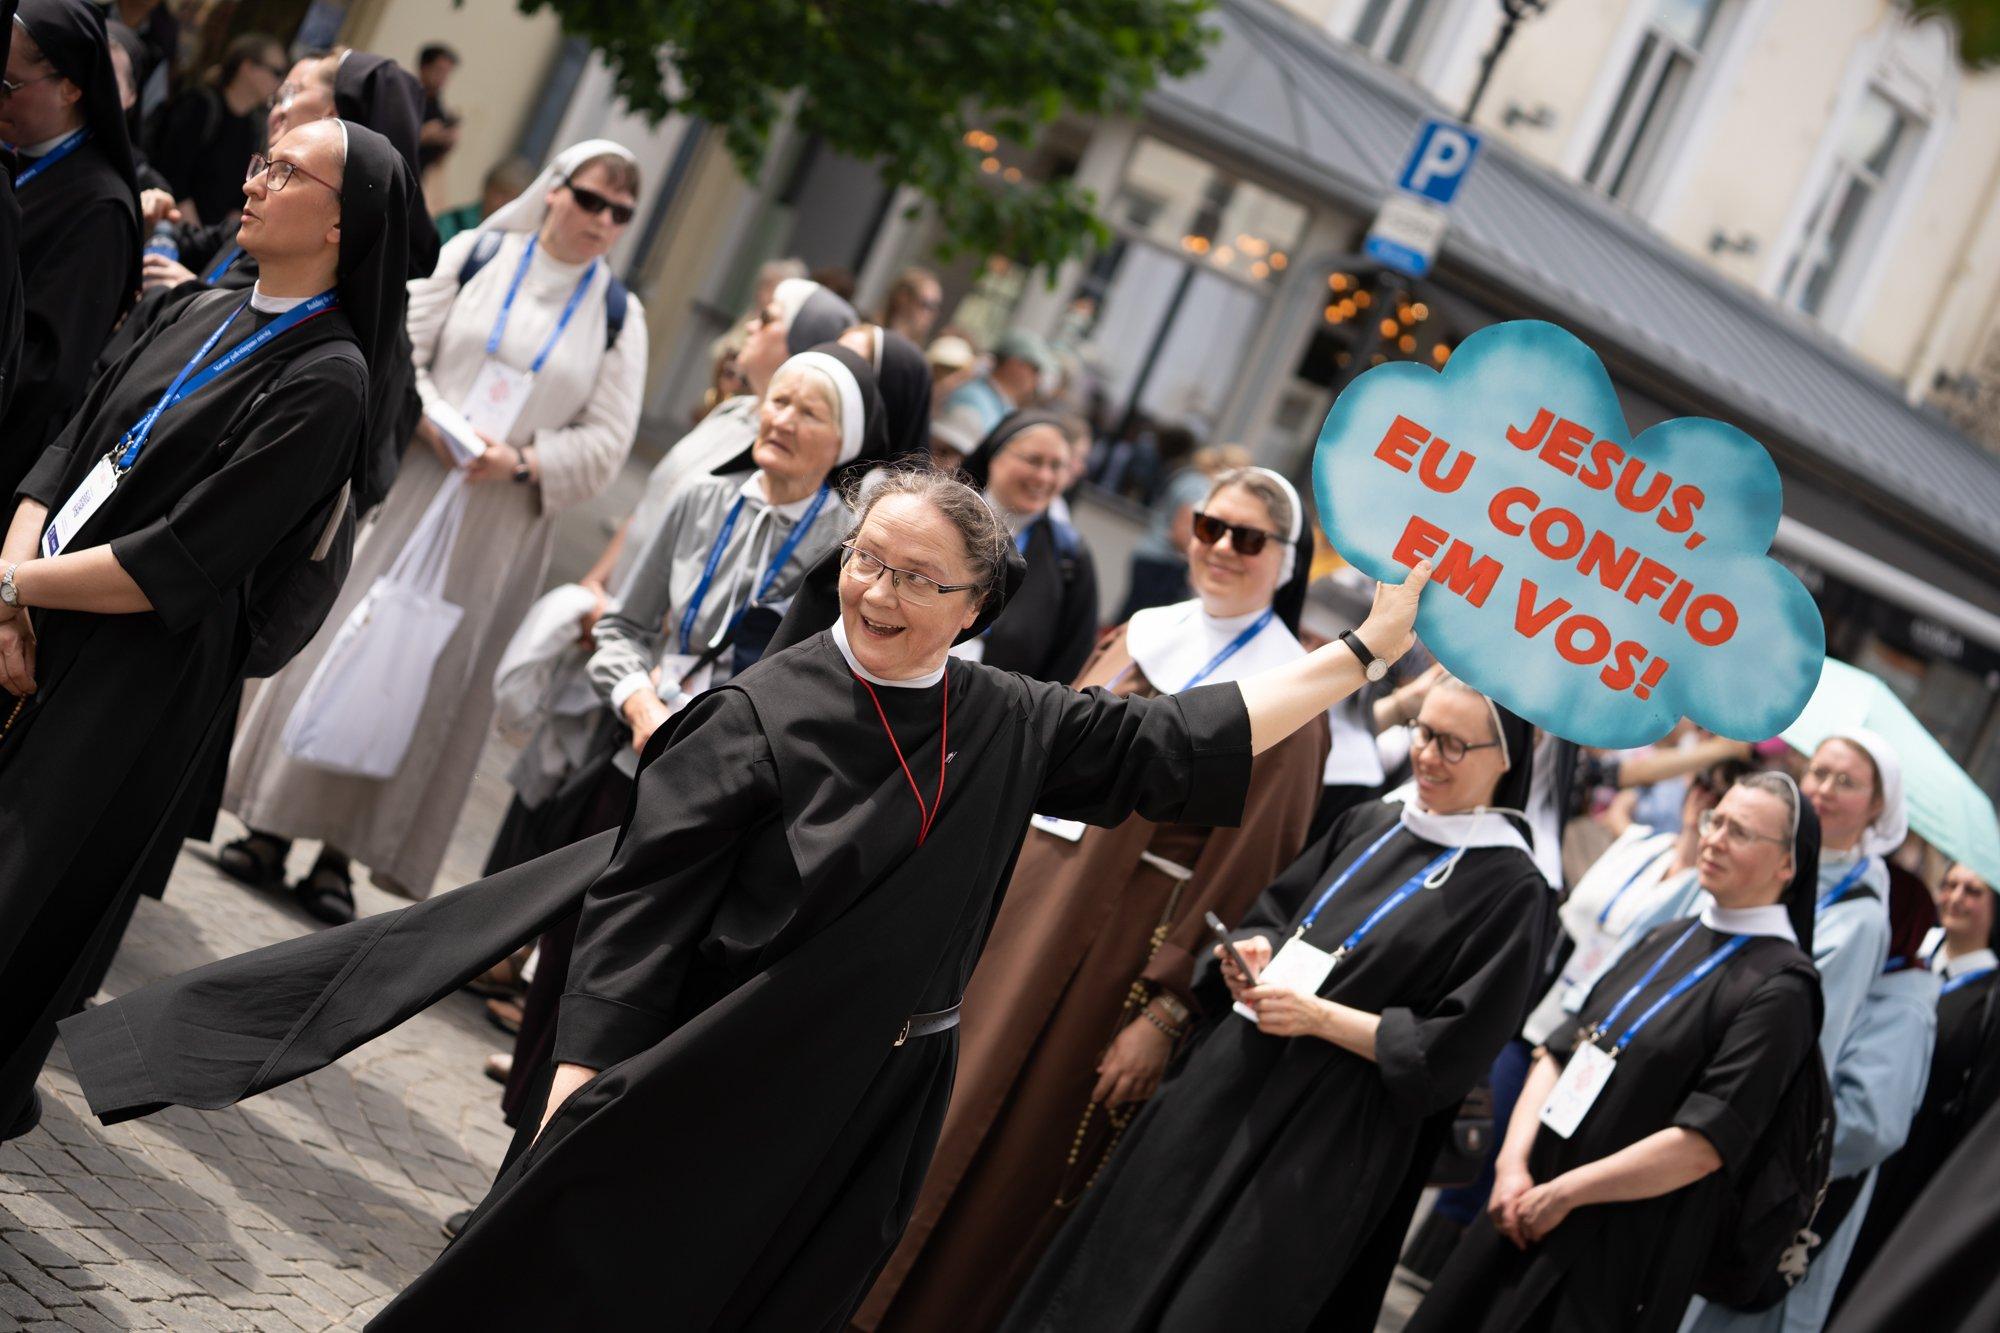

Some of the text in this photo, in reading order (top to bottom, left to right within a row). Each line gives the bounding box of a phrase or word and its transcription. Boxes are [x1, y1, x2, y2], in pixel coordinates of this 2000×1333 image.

[1409, 127, 1470, 192] P
[1373, 414, 1739, 646] EU CONFIO
[1505, 407, 1707, 551] JESUS,
[1392, 514, 1670, 701] EM VOS!
